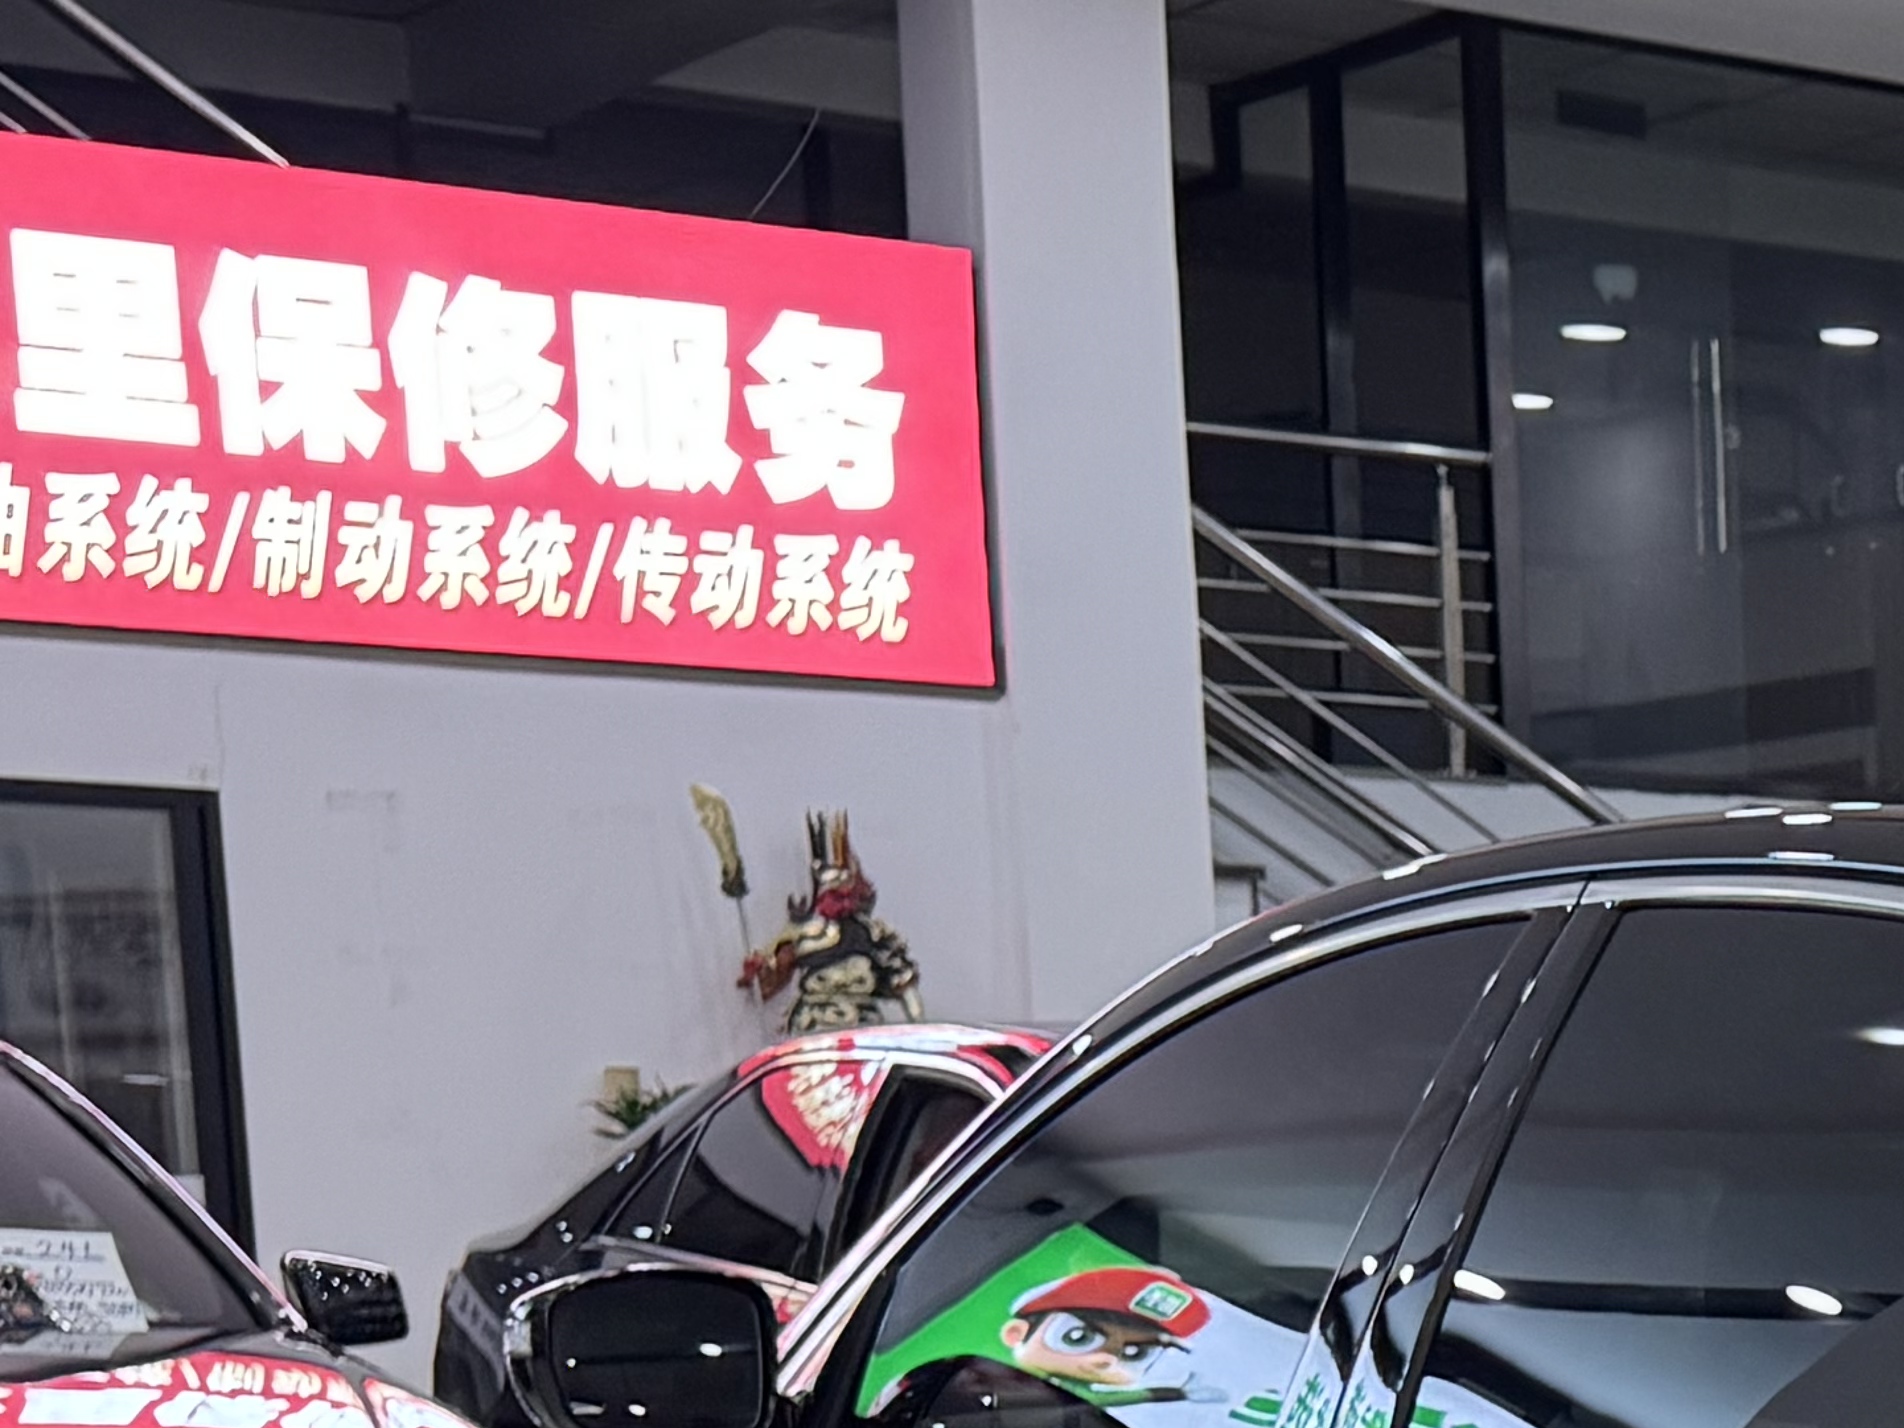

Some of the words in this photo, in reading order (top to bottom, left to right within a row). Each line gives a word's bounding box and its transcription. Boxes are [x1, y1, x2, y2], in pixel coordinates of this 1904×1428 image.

[10, 227, 905, 510] 里保修服务
